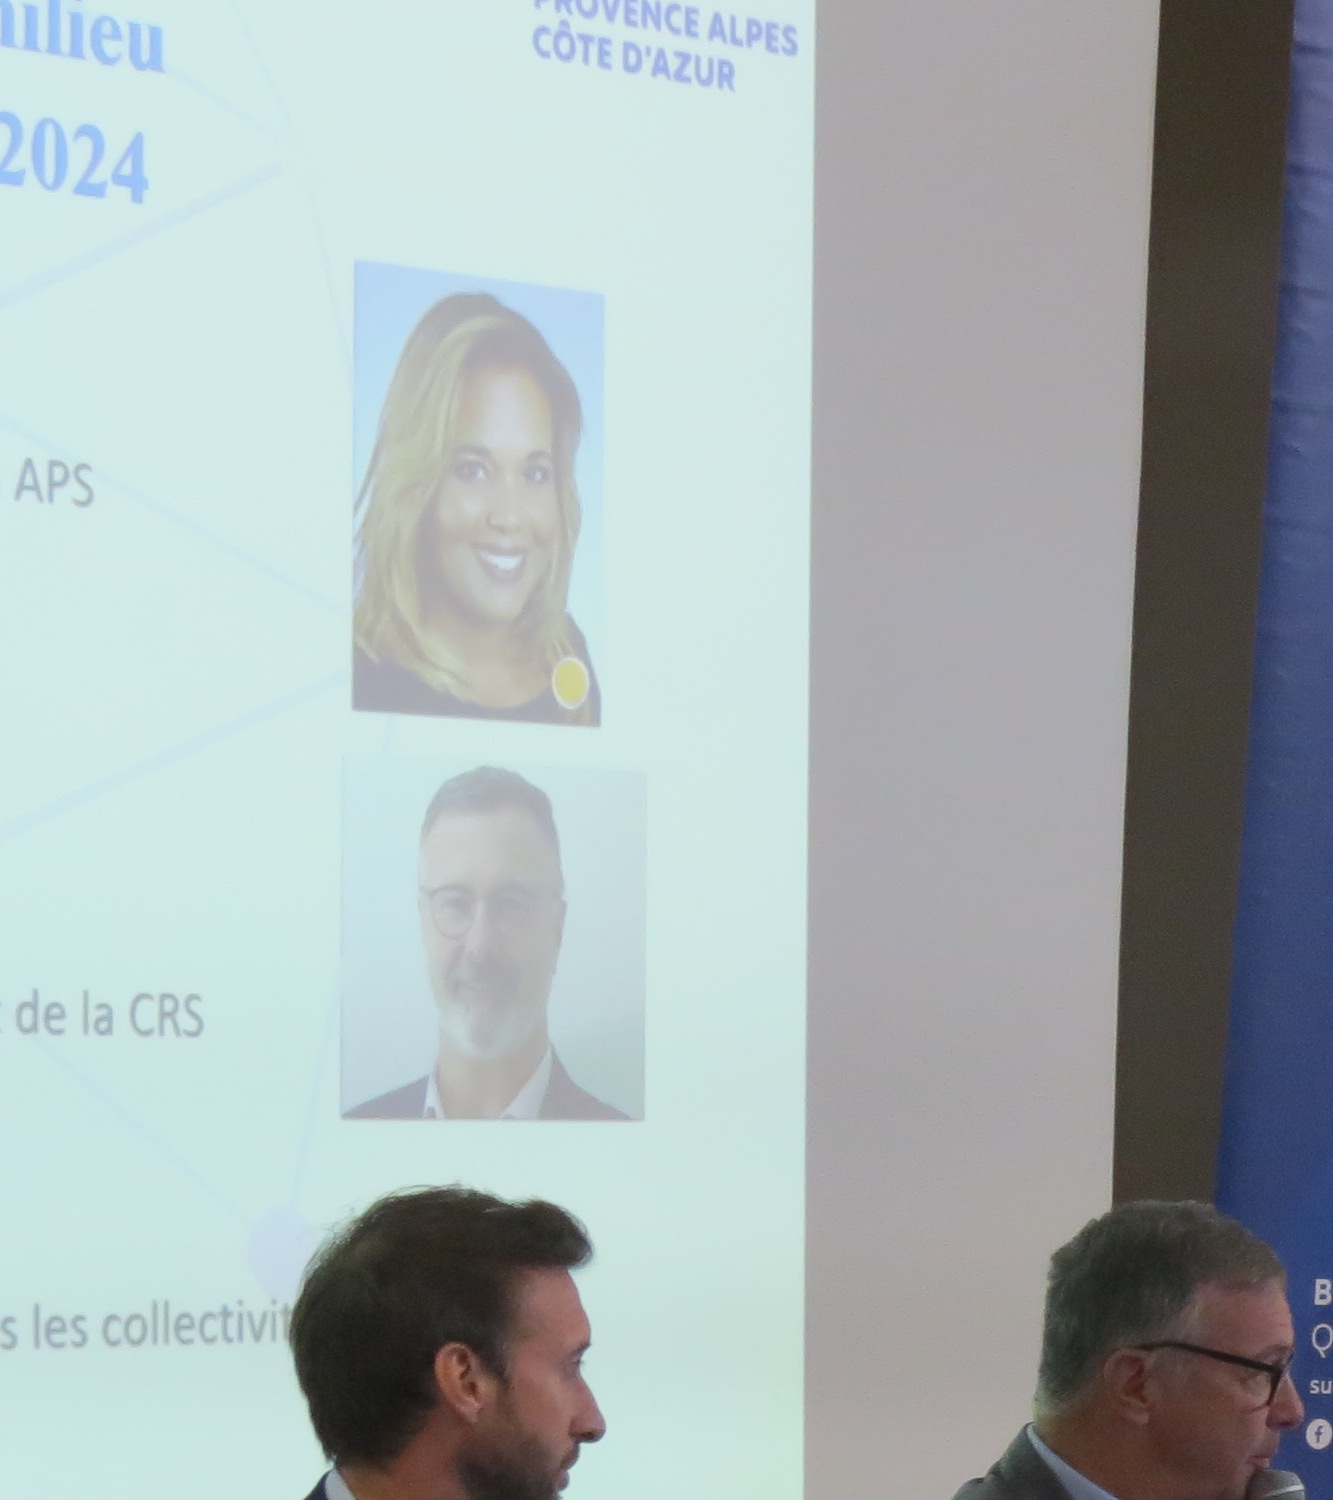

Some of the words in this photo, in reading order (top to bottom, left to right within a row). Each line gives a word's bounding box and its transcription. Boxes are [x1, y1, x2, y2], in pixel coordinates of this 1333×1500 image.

[532, 19, 613, 71] CÔTE
[621, 40, 736, 92] D'AZUR
[706, 11, 799, 57] ALPES
[0, 110, 149, 205] 2024
[14, 457, 95, 509] APS
[15, 987, 67, 1036] de
[82, 989, 114, 1036] la
[129, 992, 205, 1038] CRS
[33, 1302, 88, 1349] les
